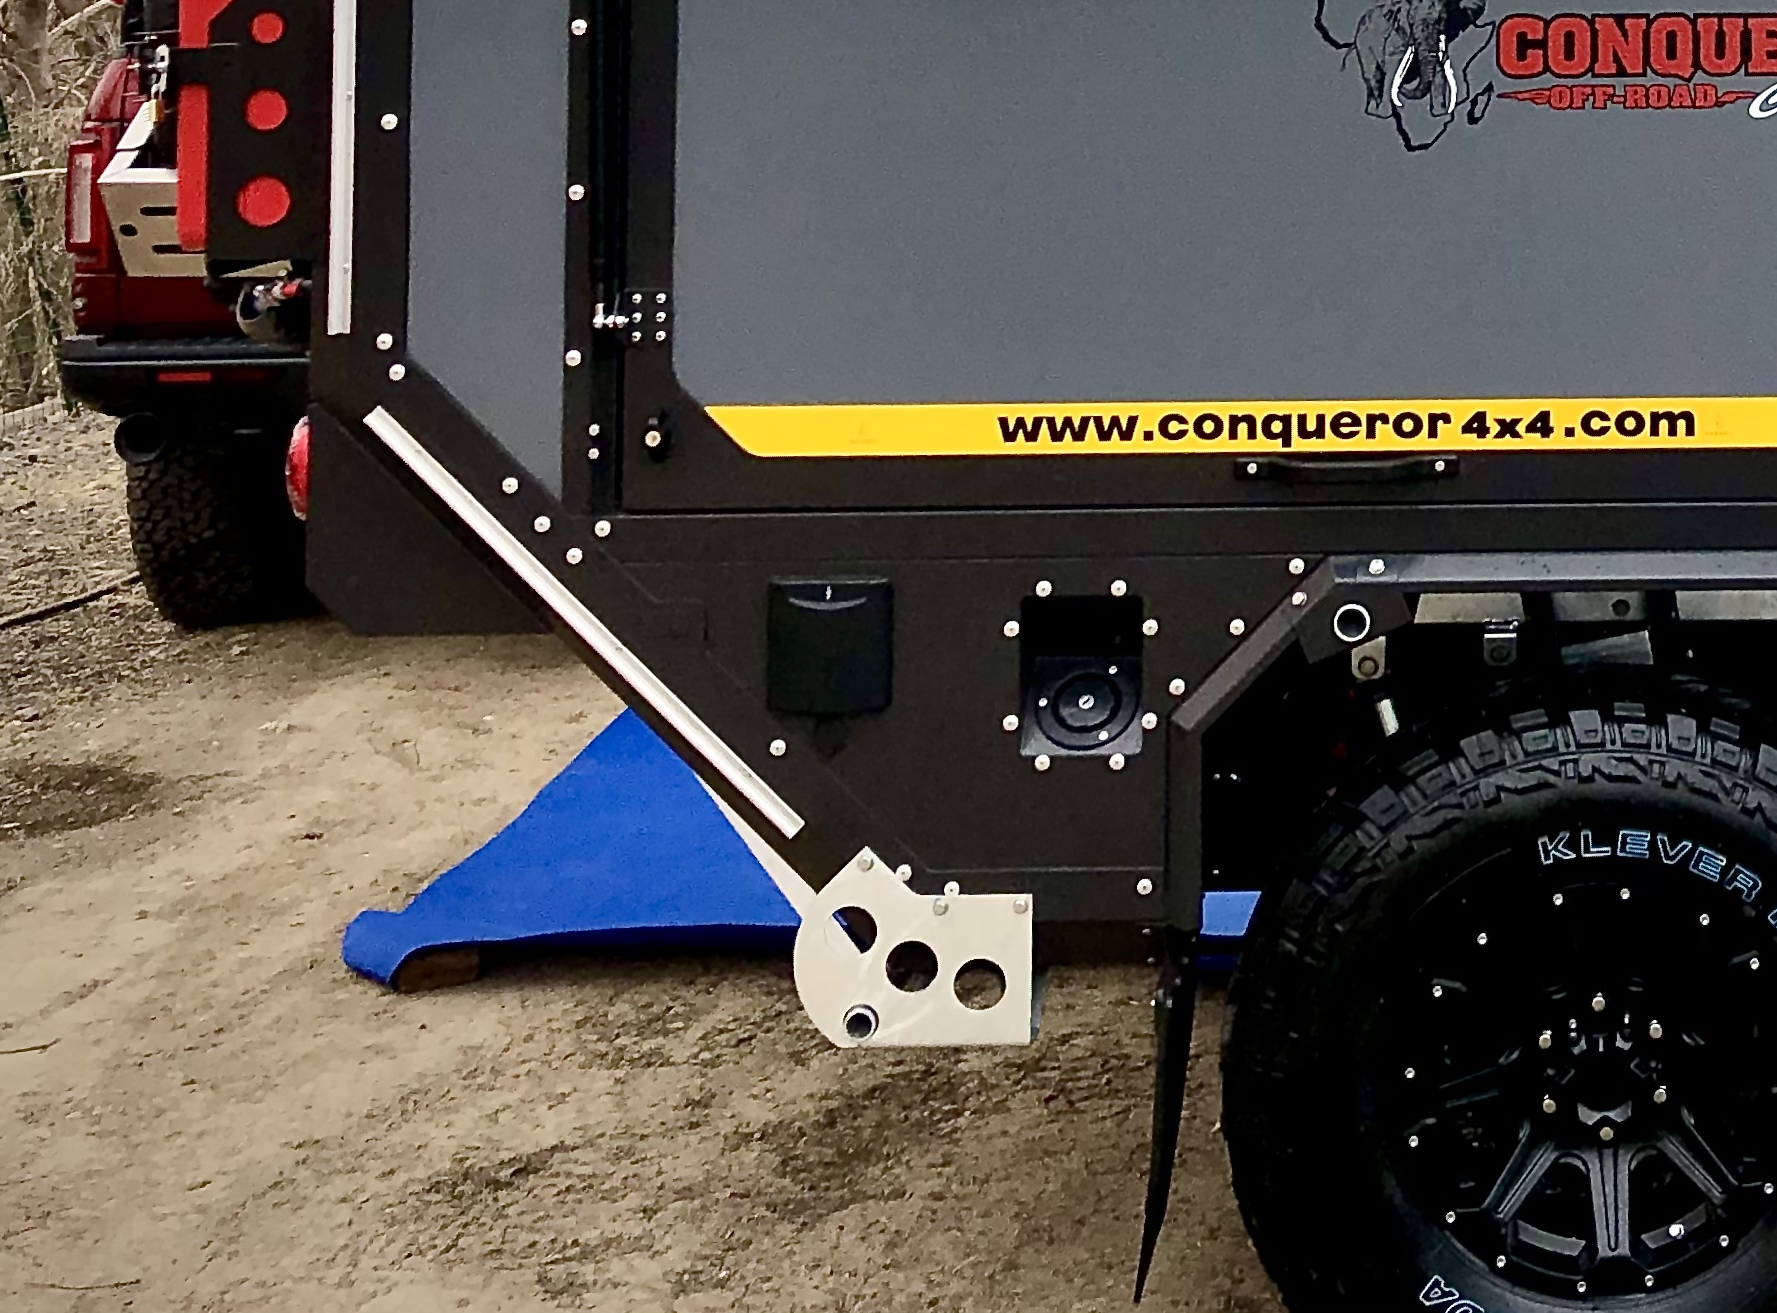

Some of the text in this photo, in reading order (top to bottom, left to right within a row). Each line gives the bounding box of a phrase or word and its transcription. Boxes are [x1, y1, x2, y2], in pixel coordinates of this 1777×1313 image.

[1549, 82, 1718, 110] OFF-ROAD
[998, 408, 1697, 448] www.conqueror4x4.com
[1537, 828, 1762, 903] KLEVER
